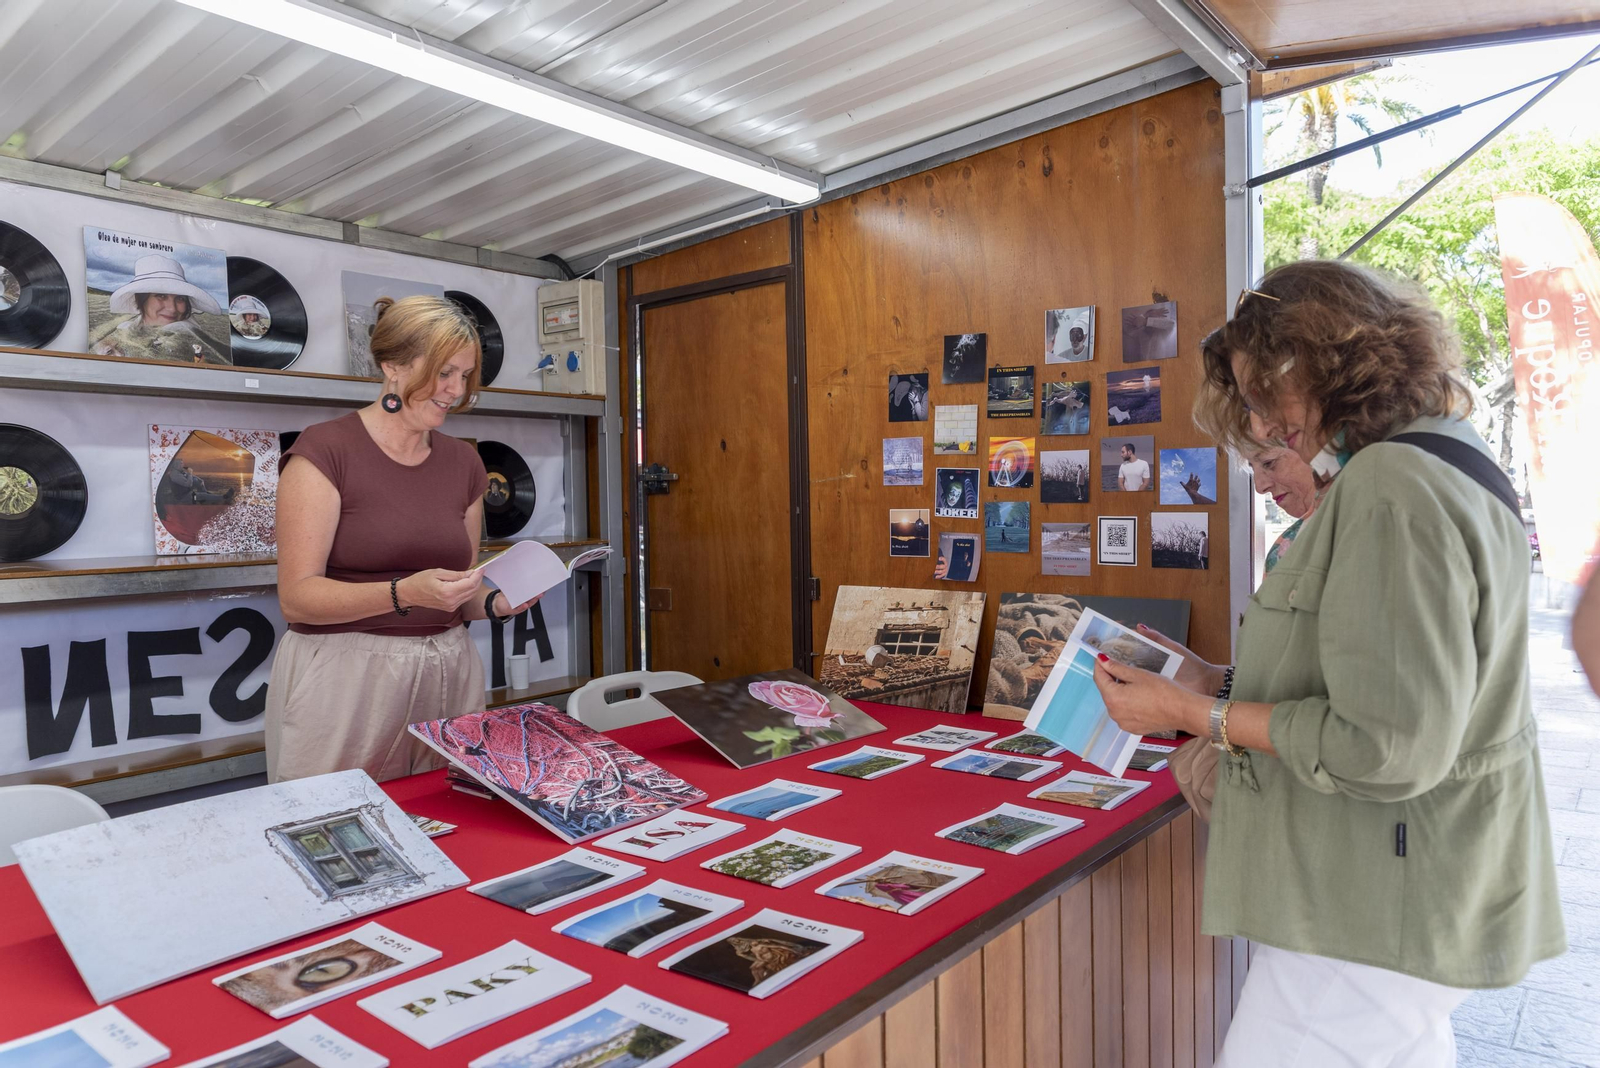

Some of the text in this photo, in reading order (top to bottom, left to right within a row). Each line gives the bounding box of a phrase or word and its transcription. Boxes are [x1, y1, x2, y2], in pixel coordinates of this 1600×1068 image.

[112, 234, 119, 244] de
[121, 237, 137, 248] mujer
[149, 242, 174, 253] sombrero
[241, 431, 260, 449] RED
[256, 440, 274, 457] RED
[935, 507, 977, 518] JOKER
[617, 820, 718, 851] ISA
[395, 956, 545, 1022] PAKY
